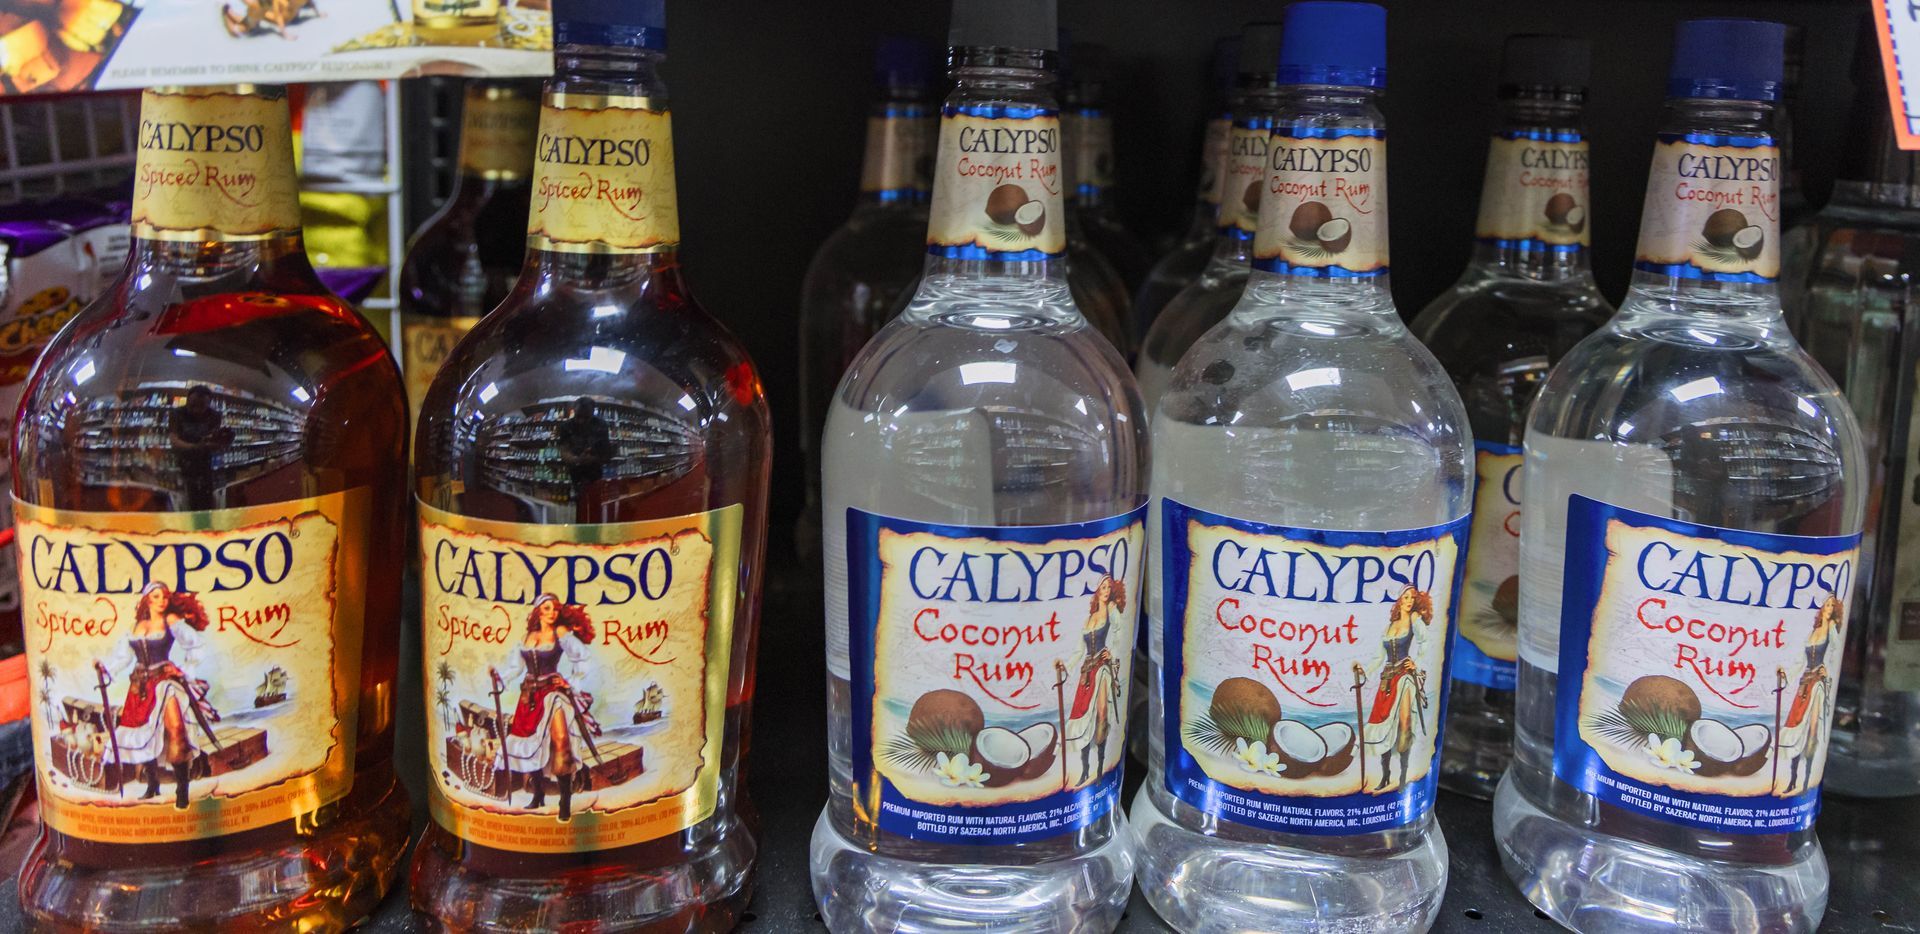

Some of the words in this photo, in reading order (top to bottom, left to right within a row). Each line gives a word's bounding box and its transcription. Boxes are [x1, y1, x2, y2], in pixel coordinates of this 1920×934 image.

[209, 64, 225, 75] TO
[141, 120, 262, 153] CALYPSO
[539, 134, 650, 166] CALYPSO
[959, 126, 1057, 154] CALYPSO
[958, 157, 1022, 184] Coconut
[1030, 159, 1059, 195] Rum
[1273, 146, 1372, 173] CALYPSO
[1678, 153, 1777, 181] CALYPSO
[141, 159, 199, 200] Spiced
[205, 168, 258, 207] Rum
[538, 172, 593, 213] Spiced
[597, 178, 645, 220] Rum
[1270, 176, 1327, 202] Coconut
[1335, 177, 1372, 214] Rum
[1675, 182, 1744, 209] Coconut
[31, 531, 294, 594] CALYPSO
[435, 538, 673, 606] CALYPSO
[910, 538, 1129, 602] CALYPSO
[1212, 539, 1435, 603] CALYPSO
[1637, 541, 1851, 610] CALYPSO
[36, 597, 118, 653] Spiced
[217, 603, 301, 648] Rum
[438, 605, 511, 655] Spiced
[603, 618, 678, 665] Rum
[913, 608, 1061, 658] Coconut
[1216, 597, 1359, 654] Coconut
[1637, 598, 1787, 655] Coconut
[953, 653, 1041, 710] Rum
[1252, 644, 1338, 707] Rum
[1675, 644, 1759, 708] Rum
[882, 801, 911, 816] PREMIUM
[912, 809, 946, 823] IMPORTED
[947, 815, 964, 824] RUM
[965, 816, 983, 825] WITH
[985, 815, 1016, 825] NATURAL
[1018, 811, 1048, 823] FLAVORS,
[1049, 808, 1063, 818] 21%
[1219, 802, 1246, 816] BOTTLED
[1247, 809, 1256, 819] BY
[1258, 812, 1288, 824] SAZERAC
[1289, 817, 1313, 826] NORTH
[1314, 819, 1346, 828] AMERICA,
[1362, 813, 1394, 825] LOUISVILLE,
[1246, 800, 1262, 809] RUM
[1263, 802, 1281, 812] WITH
[1282, 806, 1313, 816] NATURAL
[1314, 808, 1346, 817] FLAVORS,
[1347, 808, 1361, 816] 21%
[1362, 804, 1386, 815] ALC/VOL
[1616, 782, 1652, 800] IMPORTED
[1653, 793, 1670, 804] RUM
[1671, 798, 1691, 809] WITH
[1692, 802, 1723, 815] NATURAL
[1724, 807, 1754, 818] FLAVORS,
[1755, 809, 1768, 817] 21%
[1621, 793, 1652, 810] BOTTLED
[1653, 803, 1664, 812] BY
[1665, 806, 1697, 821] SAZERAC
[1698, 814, 1722, 824] NORTH
[1723, 818, 1753, 828] AMERICA,
[917, 822, 947, 834] BOTTLED
[948, 826, 959, 835] BY
[960, 827, 991, 836] SAZERAC
[993, 827, 1017, 835] NORTH
[1017, 822, 1048, 834] AMERICA,
